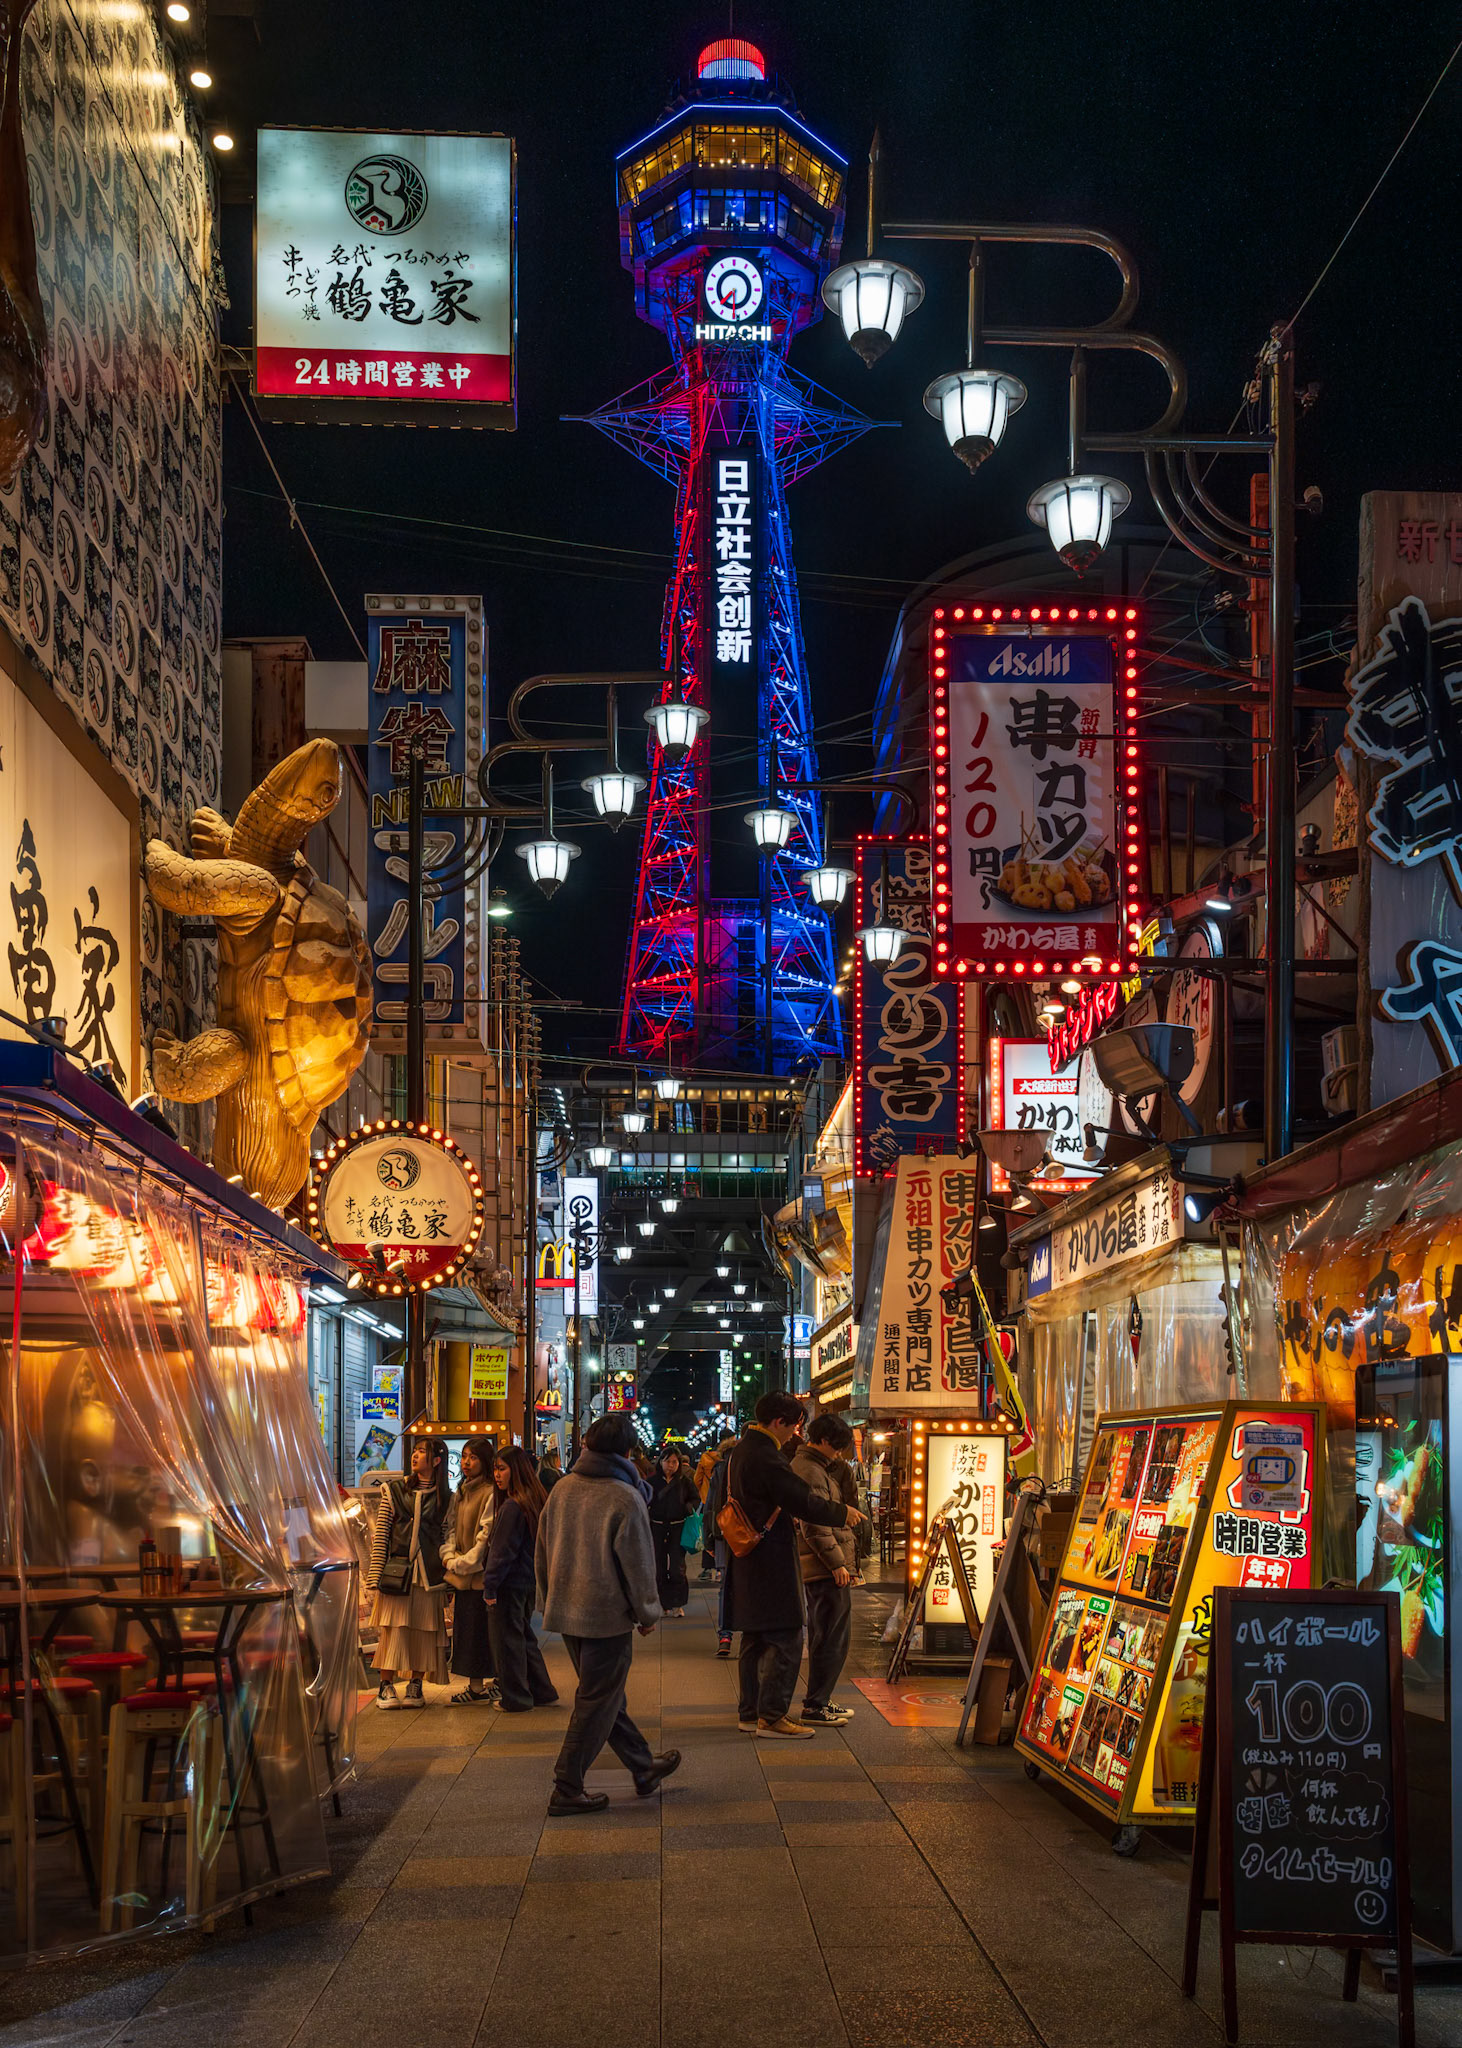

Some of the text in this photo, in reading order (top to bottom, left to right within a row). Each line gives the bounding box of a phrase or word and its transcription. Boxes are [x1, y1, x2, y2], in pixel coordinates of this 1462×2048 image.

[282, 244, 303, 298] 串かつ
[325, 244, 471, 269] 名代 つるかめや
[302, 267, 321, 321] どて焼
[325, 266, 481, 325] 鶴亀家
[695, 323, 772, 341] HITACHI
[295, 358, 471, 389] 24時間営業中
[716, 459, 753, 663] 日立社会创新
[987, 643, 1072, 677] Asahi
[372, 618, 455, 775] 麻雀
[1005, 689, 1087, 862] 串カツ
[374, 830, 460, 1020] マルコ
[981, 926, 1081, 950] かわち屋
[1084, 927, 1097, 950] 本店
[1015, 1102, 1077, 1130] かわ
[367, 1207, 452, 1239] 鶴亀家
[1068, 1190, 1137, 1273] かわち屋
[366, 1248, 430, 1264] 中無休
[905, 1169, 933, 1392] 元祖串カツ専門店
[475, 1354, 504, 1362] ポケカ
[884, 1324, 900, 1392] 通天閣店
[474, 1379, 504, 1390] 販売中
[1214, 1512, 1308, 1558] 時間営業
[935, 1554, 950, 1585] 本店
[1248, 1558, 1285, 1581] 年中
[1236, 1616, 1380, 1647] ハイボール
[1244, 1652, 1287, 1674] 一杯
[1301, 1778, 1338, 1798] 何杯
